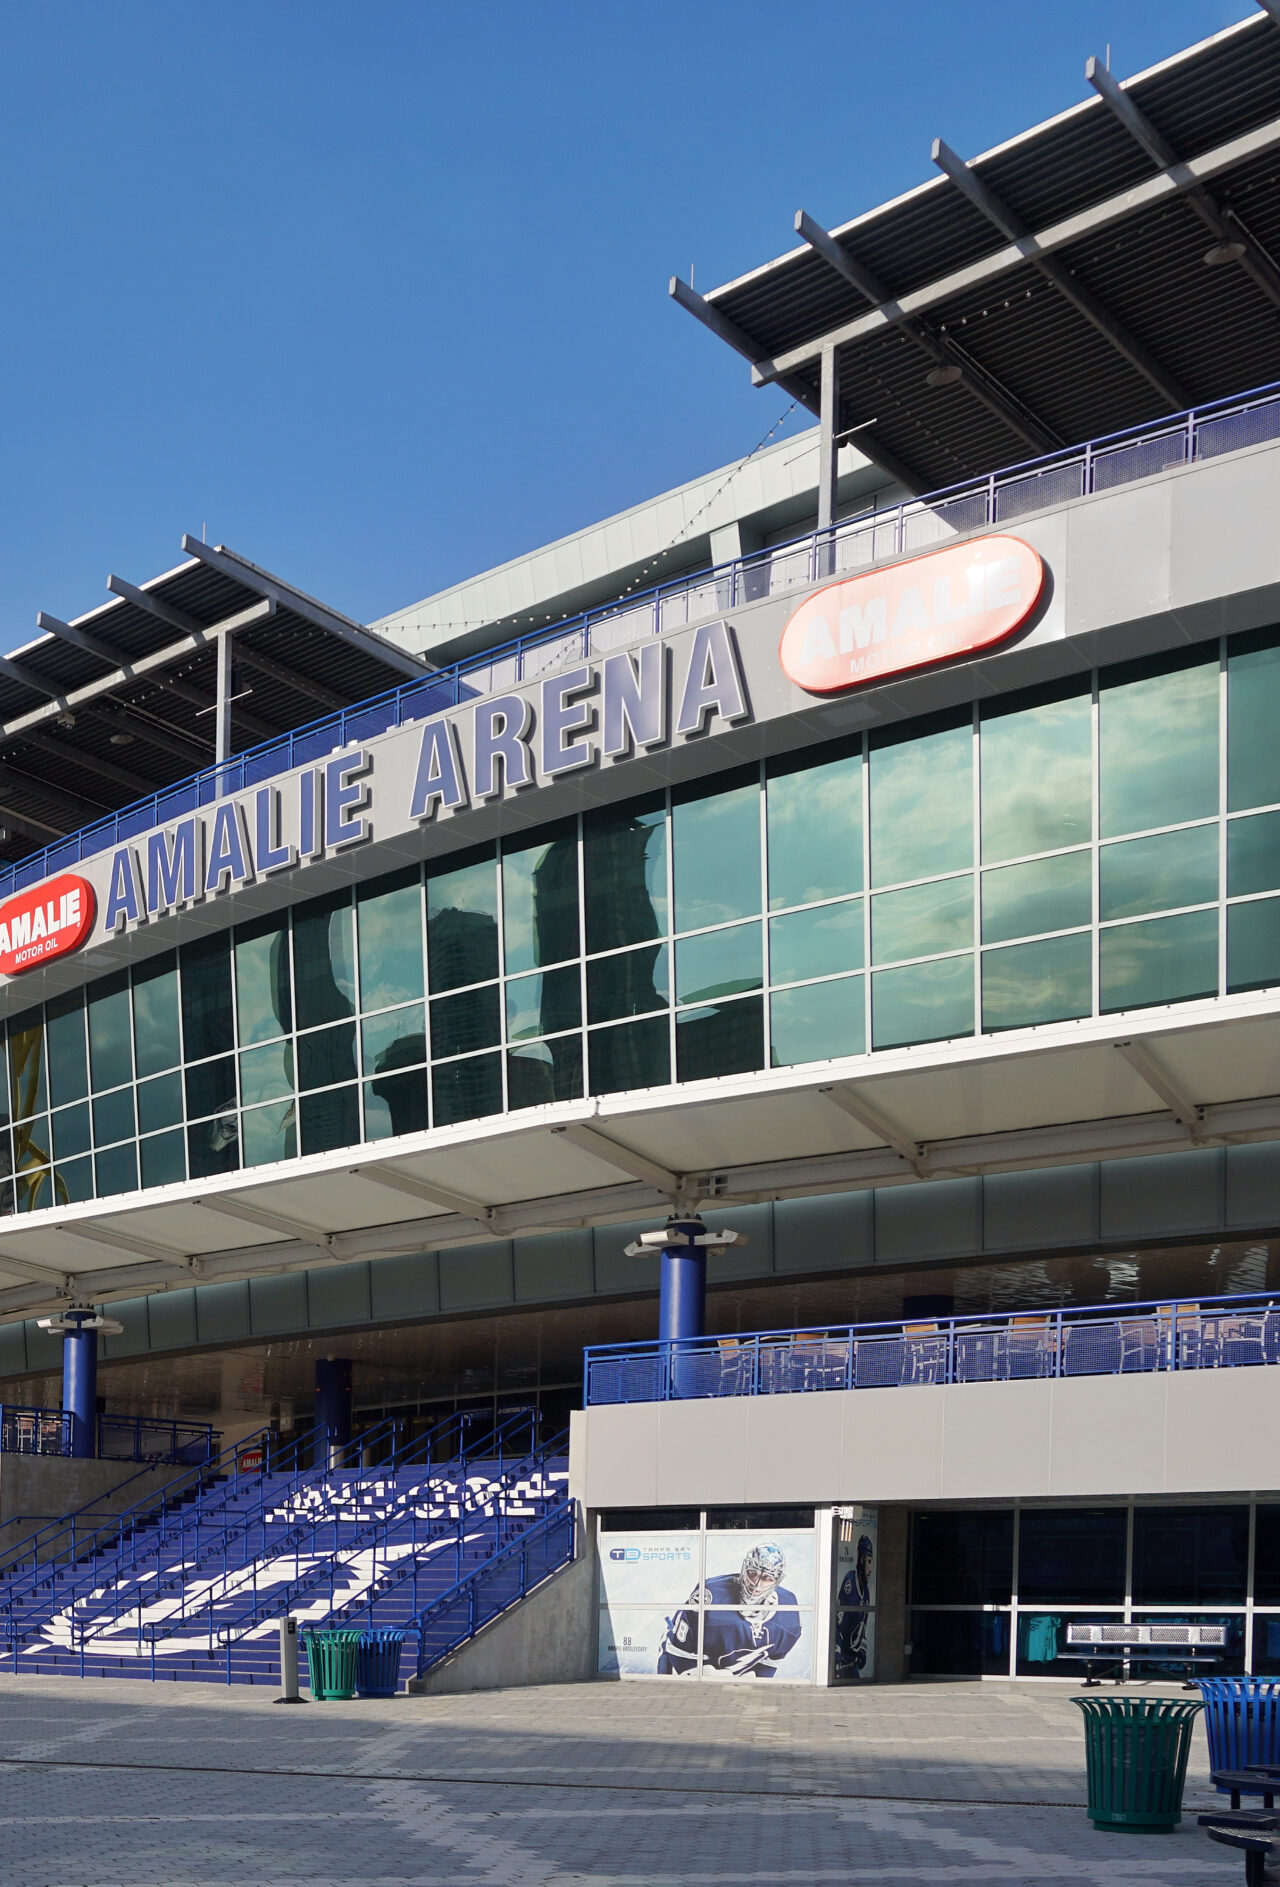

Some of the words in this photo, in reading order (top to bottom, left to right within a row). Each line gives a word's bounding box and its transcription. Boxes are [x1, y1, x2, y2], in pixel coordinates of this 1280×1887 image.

[799, 555, 1023, 666] AMALIE
[849, 640, 920, 674] MOTOR
[928, 632, 962, 648] OIL
[104, 749, 371, 932] AMALIE
[408, 619, 748, 822] ARENA
[15, 946, 43, 964] MOTOR
[45, 938, 58, 951] OIL
[643, 1552, 691, 1561] SPORTS
